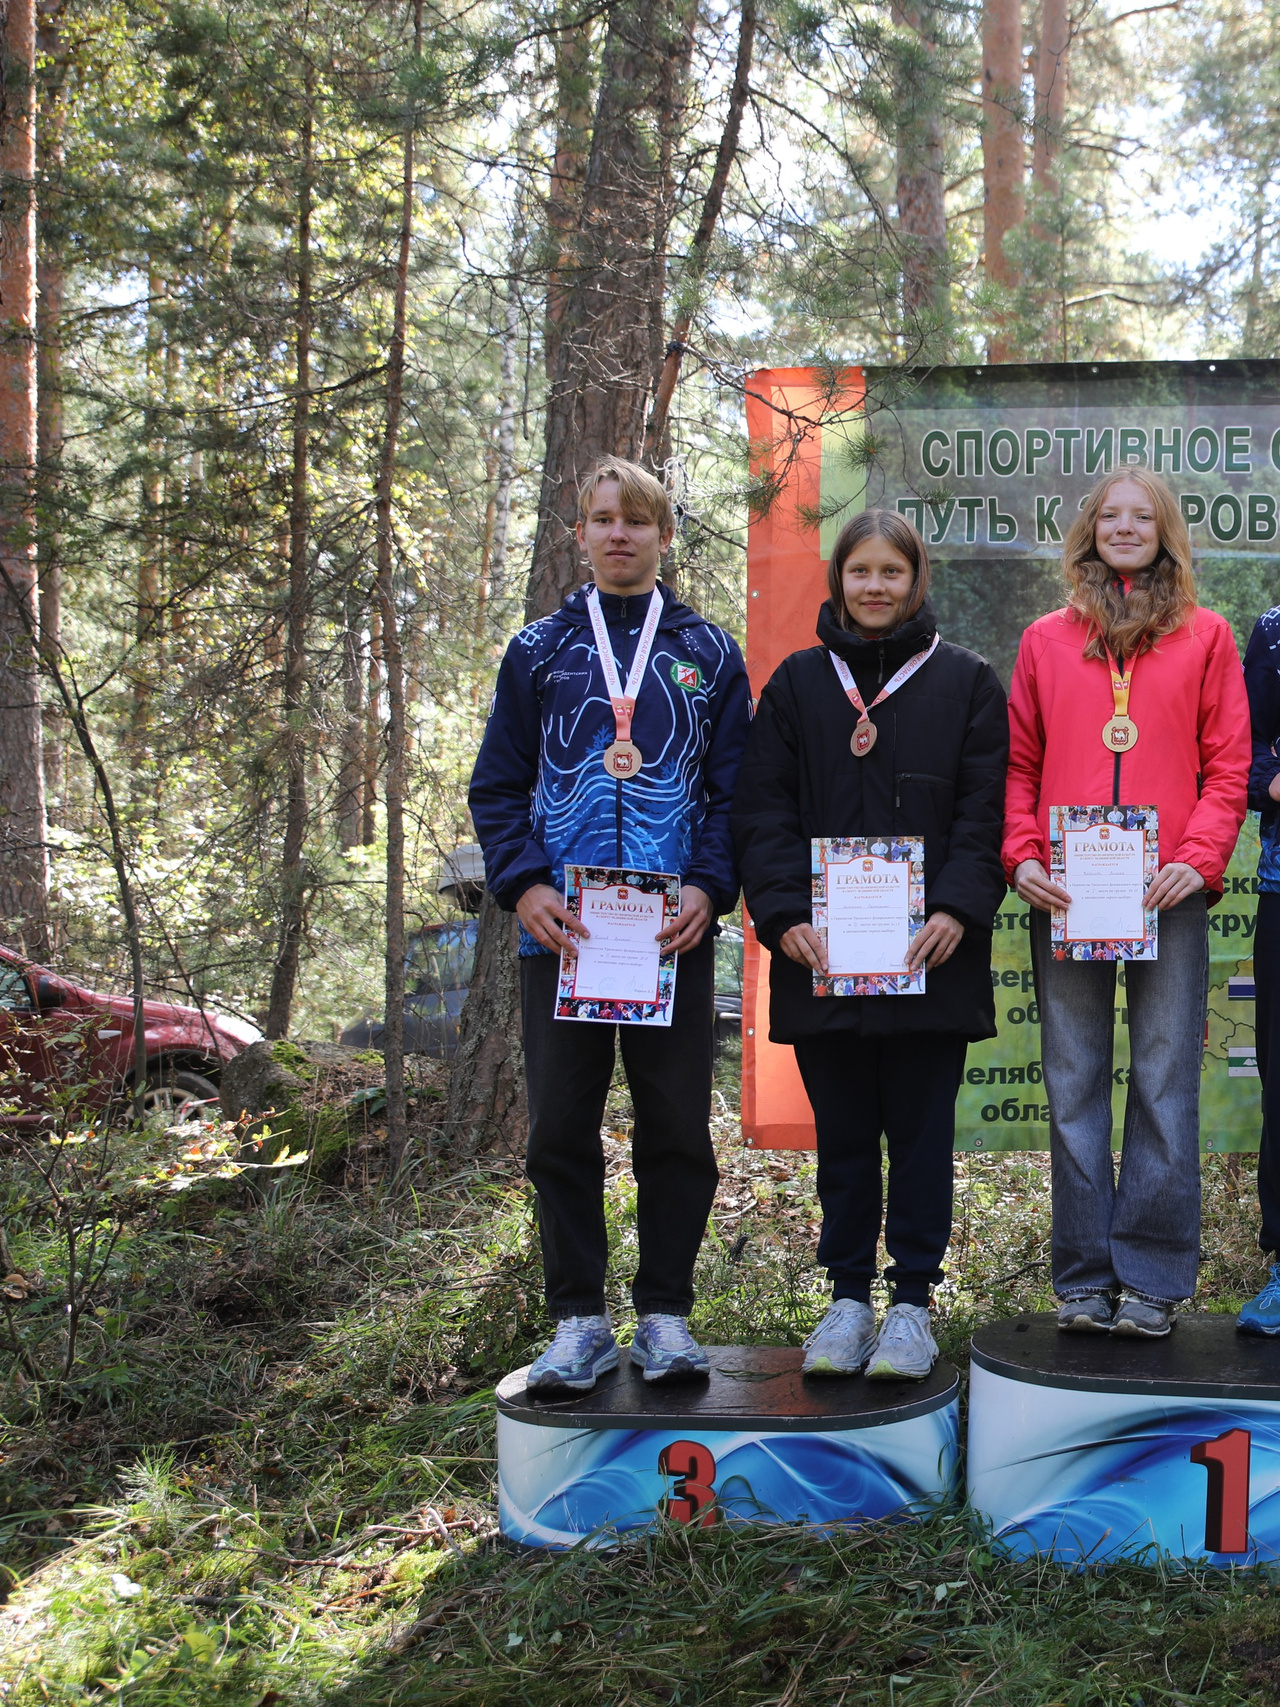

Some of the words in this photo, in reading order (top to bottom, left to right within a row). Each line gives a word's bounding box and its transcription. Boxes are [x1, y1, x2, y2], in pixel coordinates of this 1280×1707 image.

[921, 426, 1252, 478] СПОРТИВНОЕ
[897, 496, 1018, 544] ПУТЬ
[1036, 496, 1064, 543] К
[1074, 842, 1135, 852] ГРАМОТА
[836, 874, 900, 884] ГРАМОТА
[591, 900, 654, 913] ГРАМОТА
[981, 1098, 1050, 1122] обла
[658, 1439, 718, 1528] 3
[1190, 1427, 1252, 1554] 1
